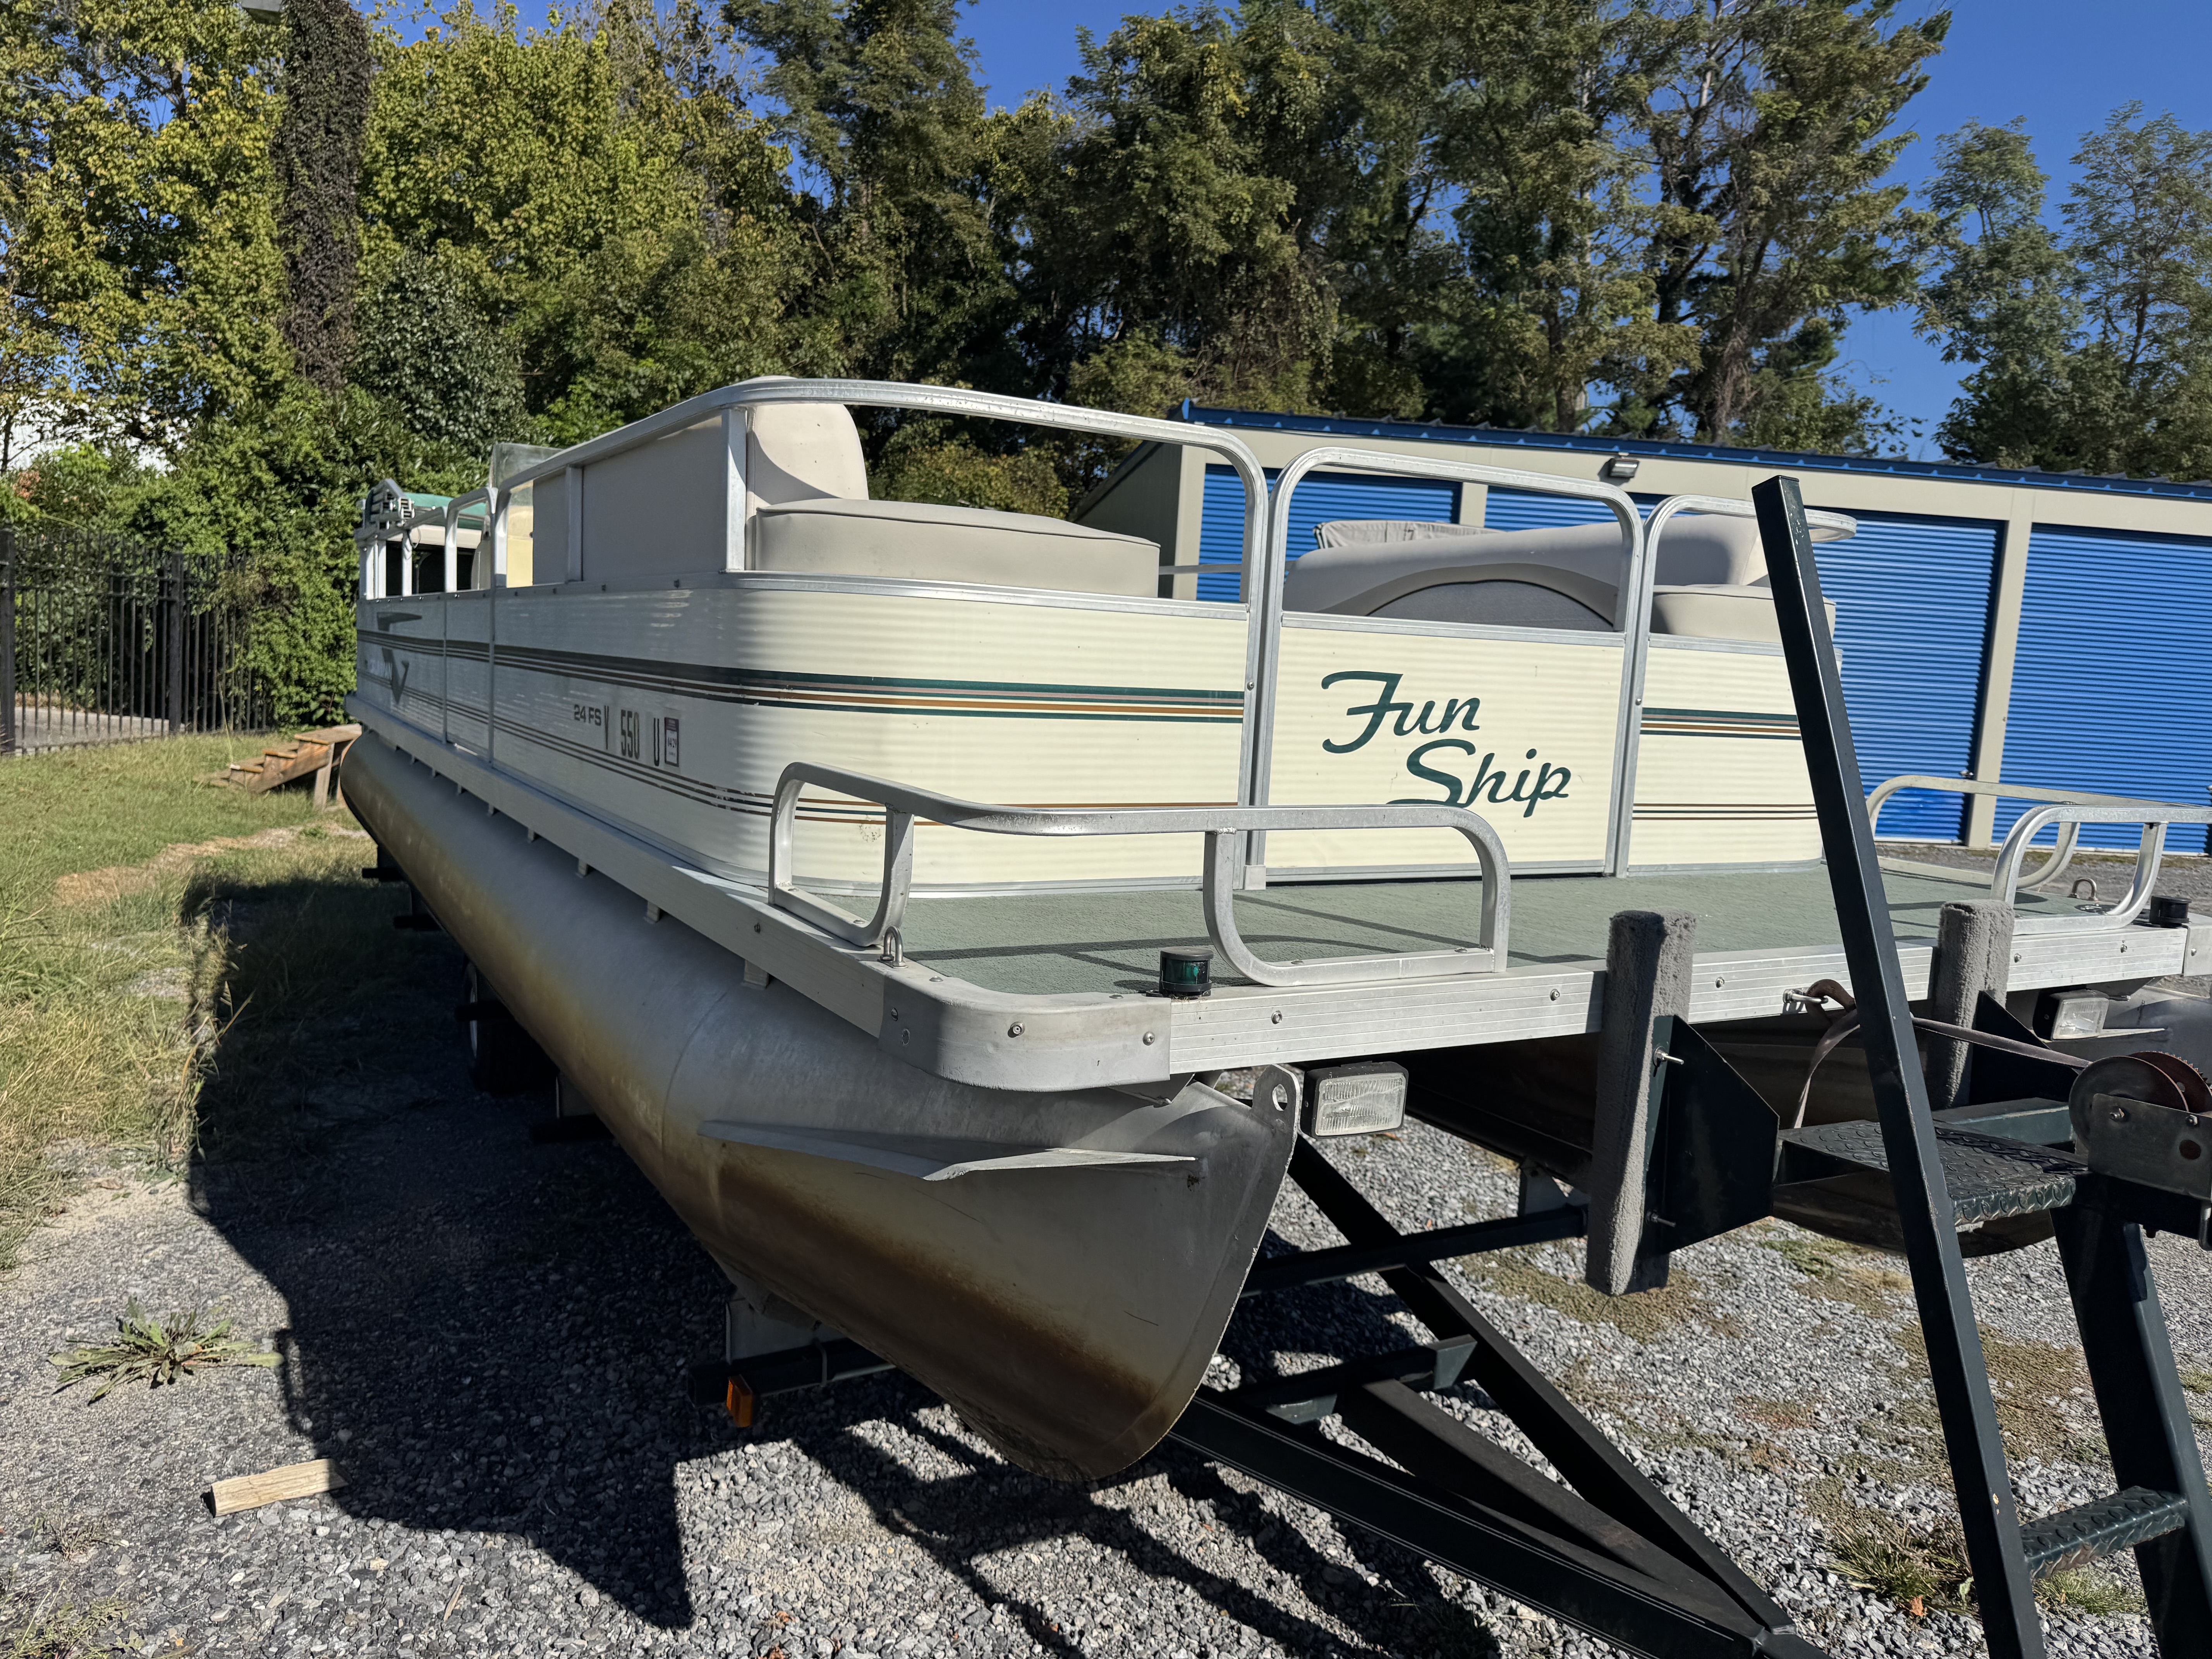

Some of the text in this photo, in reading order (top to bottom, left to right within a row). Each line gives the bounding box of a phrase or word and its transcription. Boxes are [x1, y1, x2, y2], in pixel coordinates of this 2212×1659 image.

[574, 704, 601, 726] 24 FS
[1321, 671, 1480, 754] Fun
[1385, 738, 1571, 818] Ship
